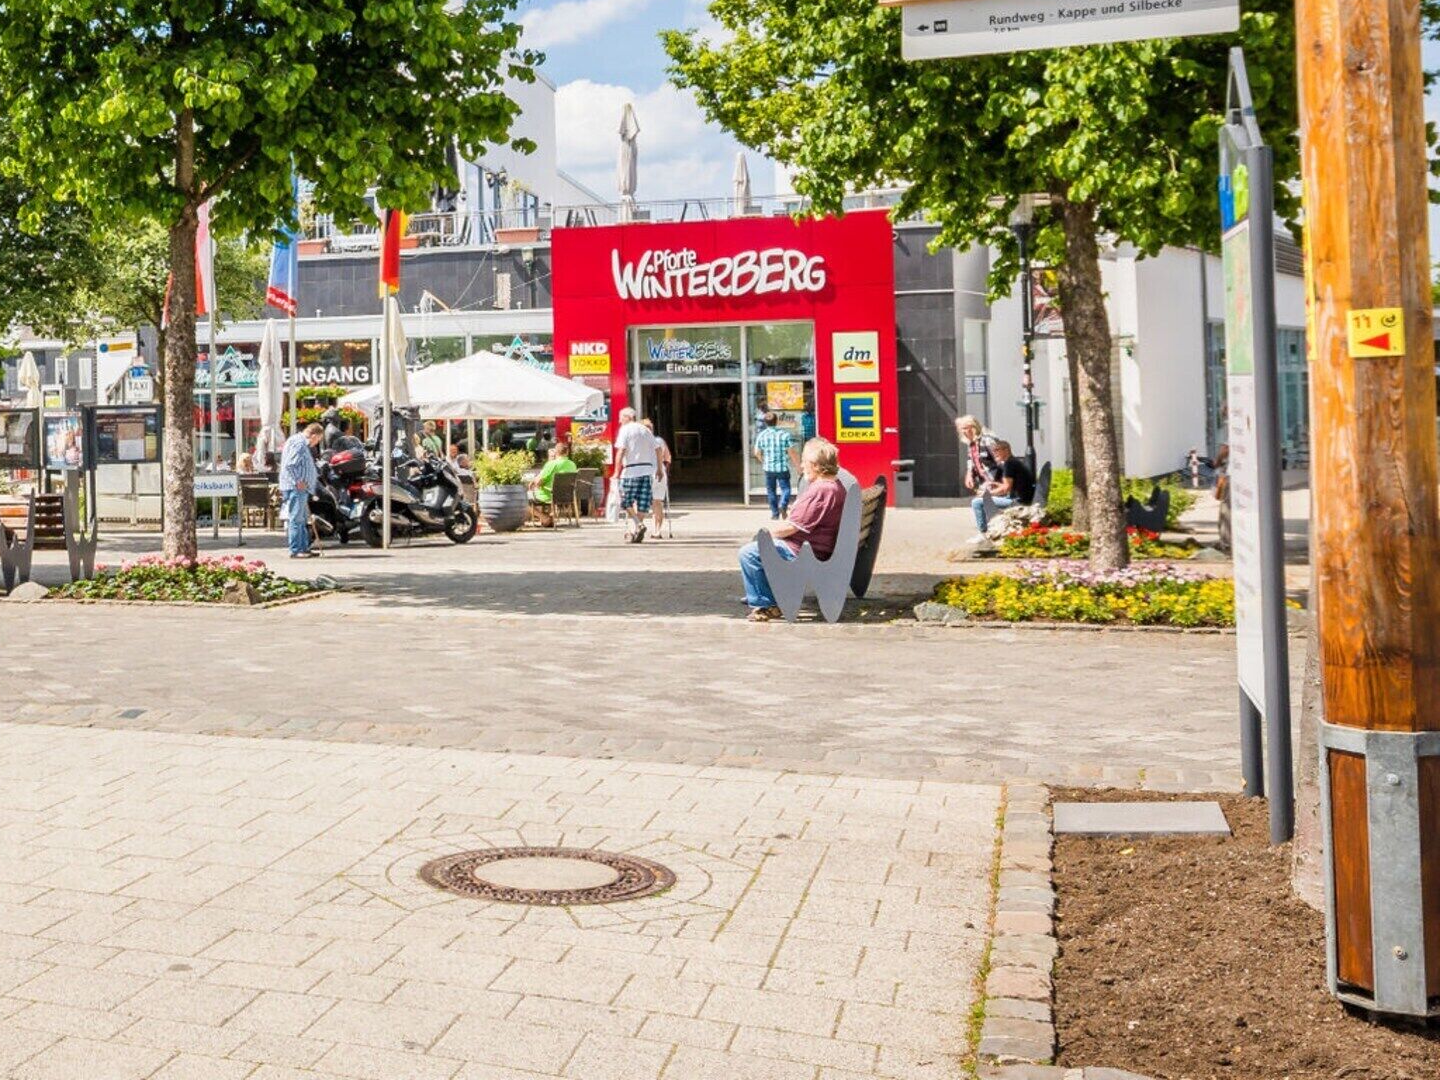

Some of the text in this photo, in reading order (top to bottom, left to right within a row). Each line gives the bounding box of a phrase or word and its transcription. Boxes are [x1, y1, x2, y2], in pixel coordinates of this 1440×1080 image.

[989, 10, 1045, 26] Rundweg
[1058, 6, 1096, 20] Kappe
[1102, 3, 1124, 14] und
[654, 247, 697, 272] Pforte
[571, 342, 608, 355] NKD
[844, 346, 871, 360] dm
[281, 366, 369, 383] EINGANG
[665, 363, 714, 374] Eingang
[193, 481, 234, 490] olksbank
